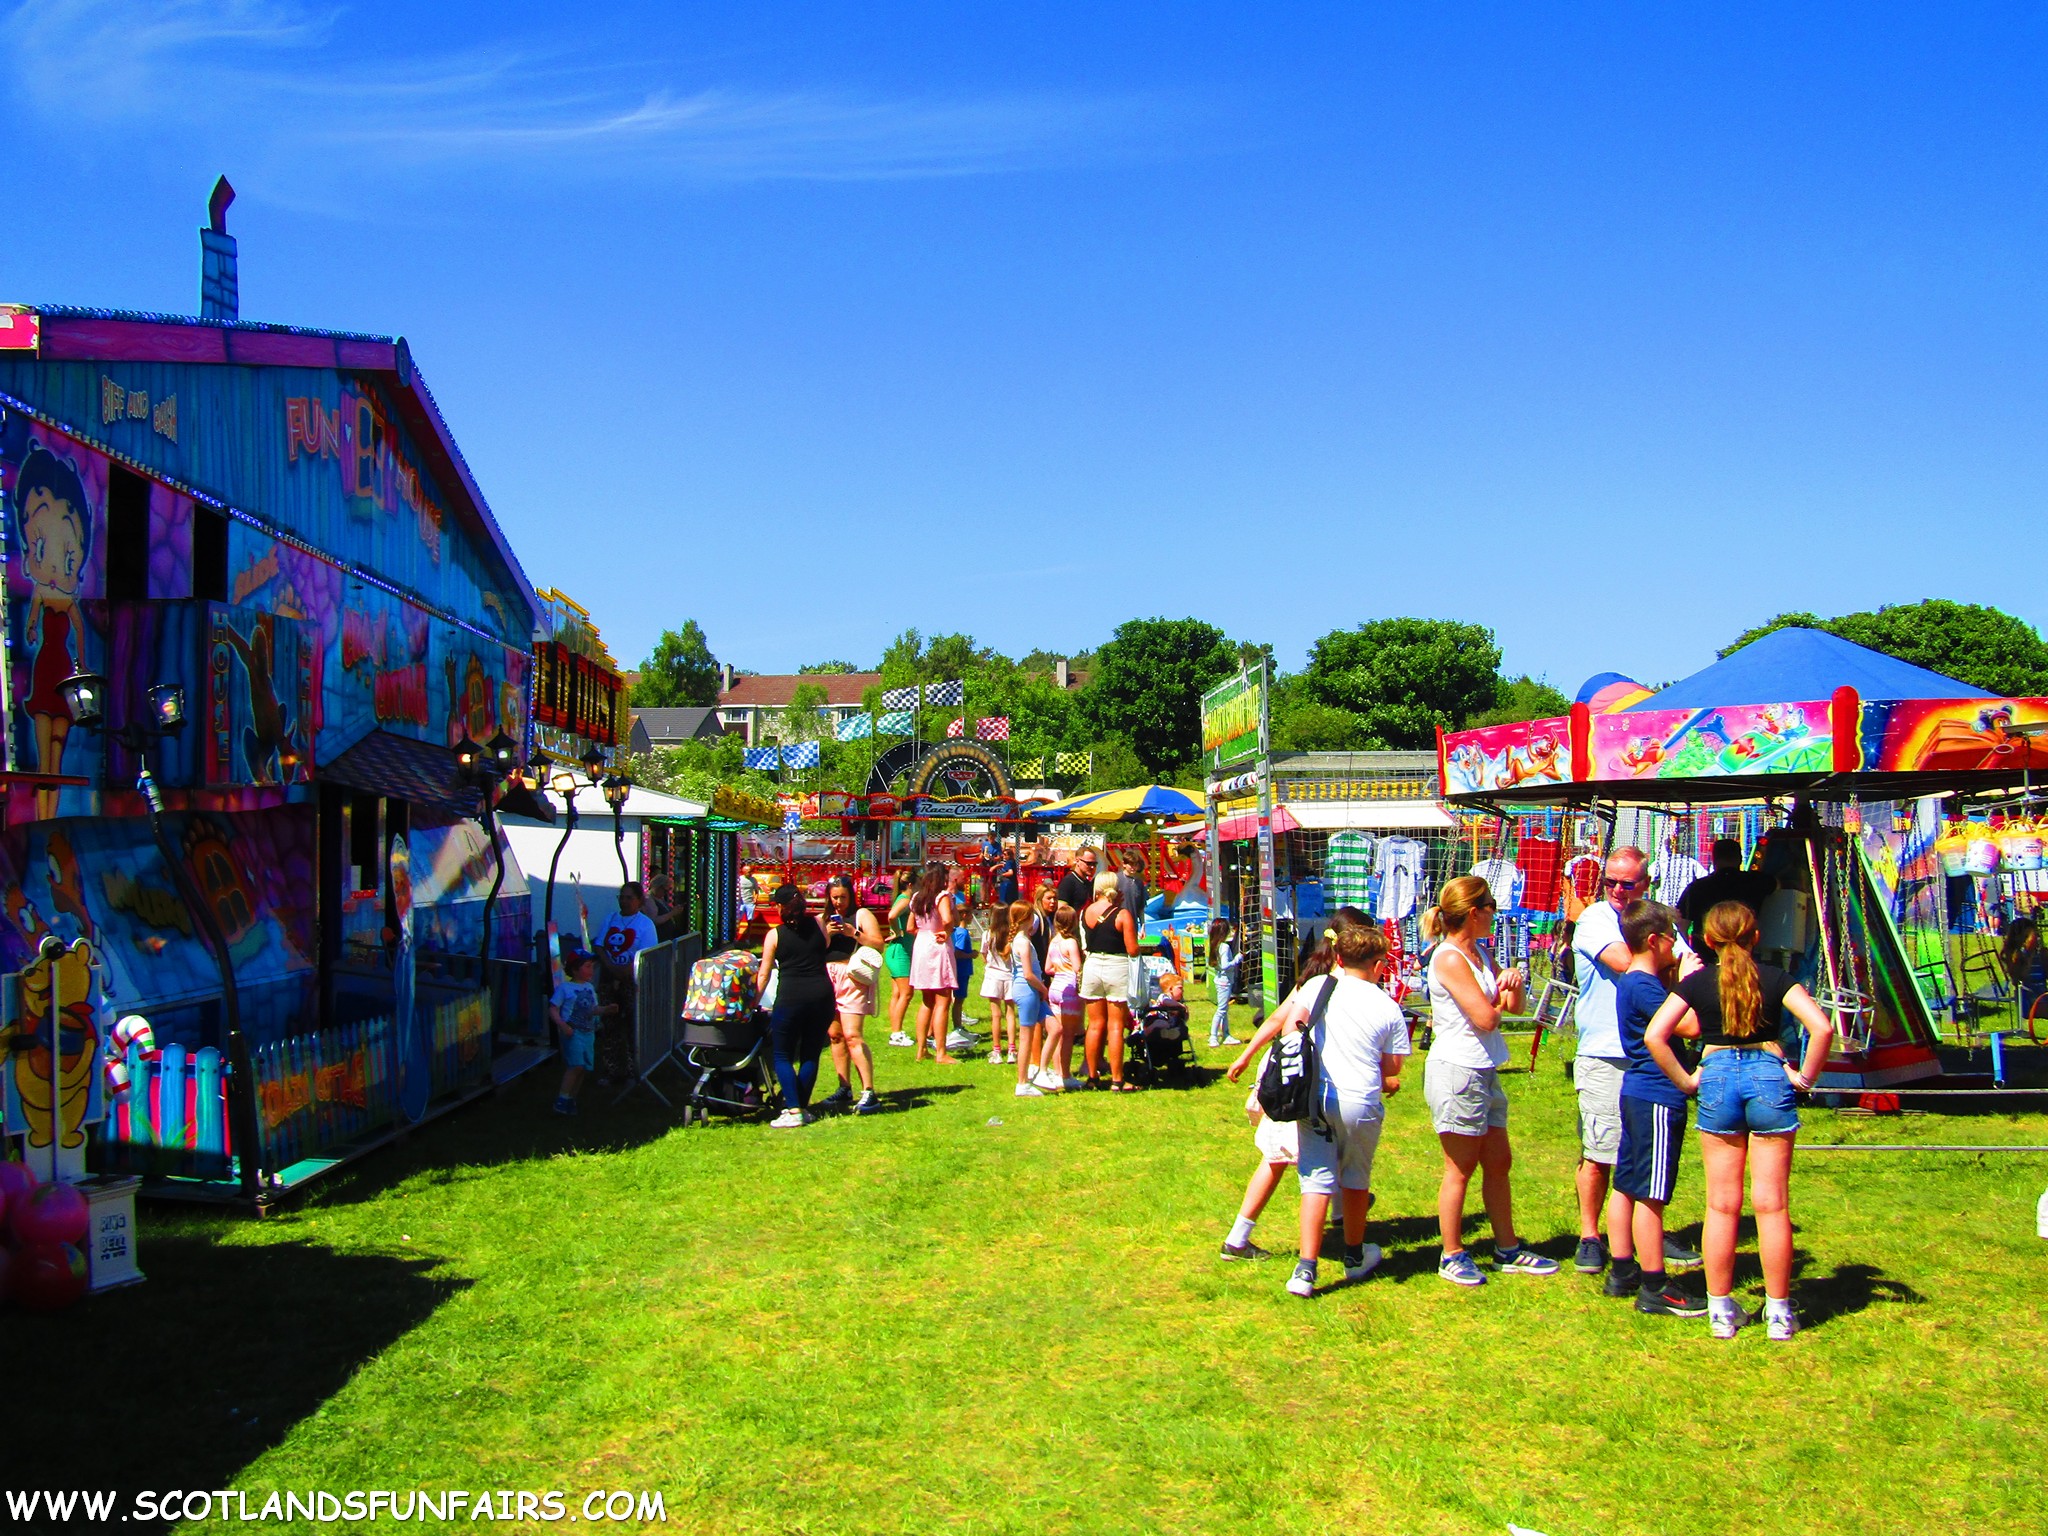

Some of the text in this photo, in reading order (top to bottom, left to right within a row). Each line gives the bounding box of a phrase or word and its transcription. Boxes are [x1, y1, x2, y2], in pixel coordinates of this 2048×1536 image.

[127, 390, 149, 419] AND
[286, 397, 442, 564] FUN HOUSE
[212, 612, 230, 763] HOUSE
